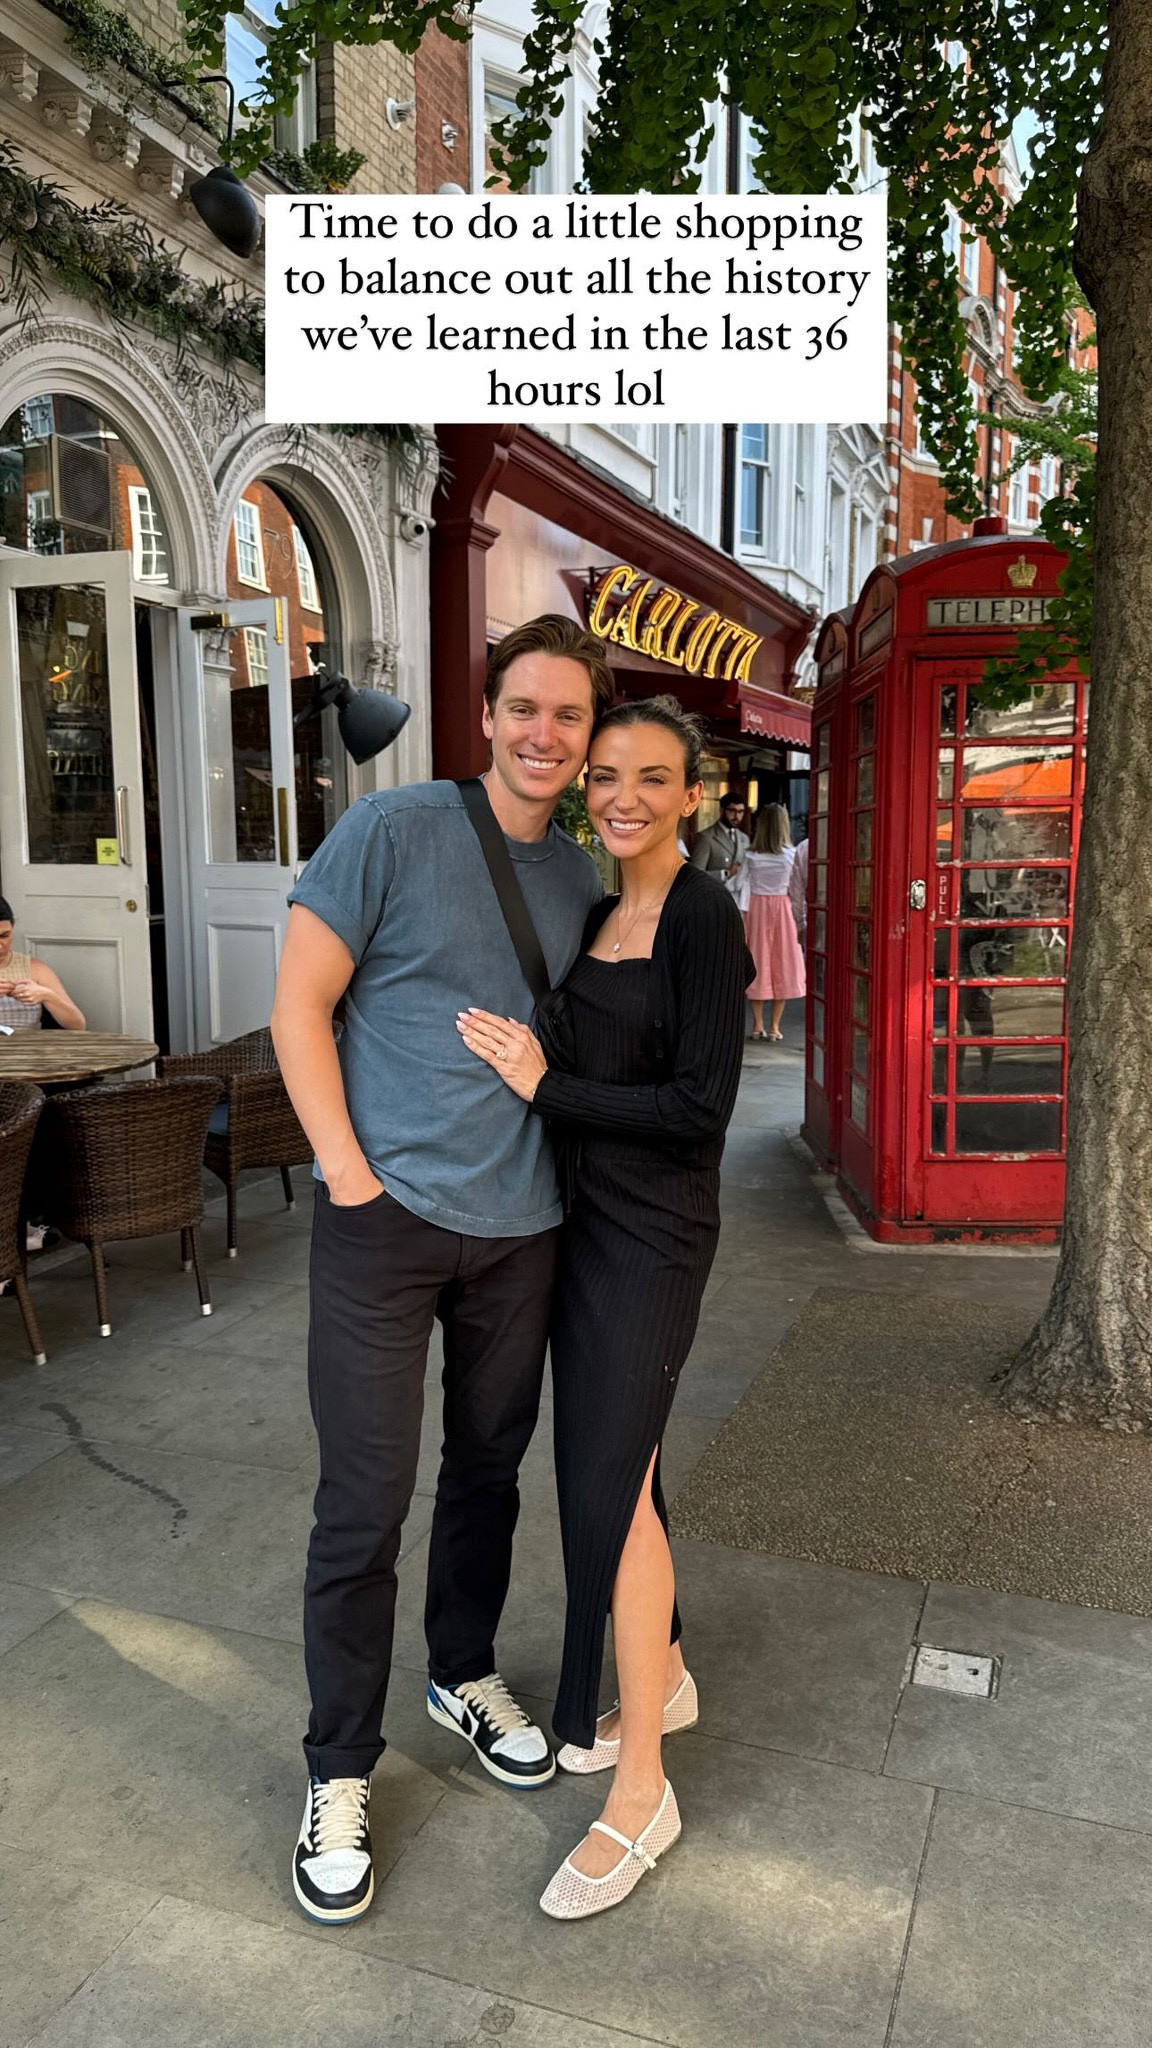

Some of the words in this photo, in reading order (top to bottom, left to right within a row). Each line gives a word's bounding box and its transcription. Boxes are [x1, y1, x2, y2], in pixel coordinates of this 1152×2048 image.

[263, 528, 295, 579] 79
[589, 564, 765, 683] CARLOTTA
[934, 600, 1046, 624] TELEPH
[938, 875, 948, 915] PULL
